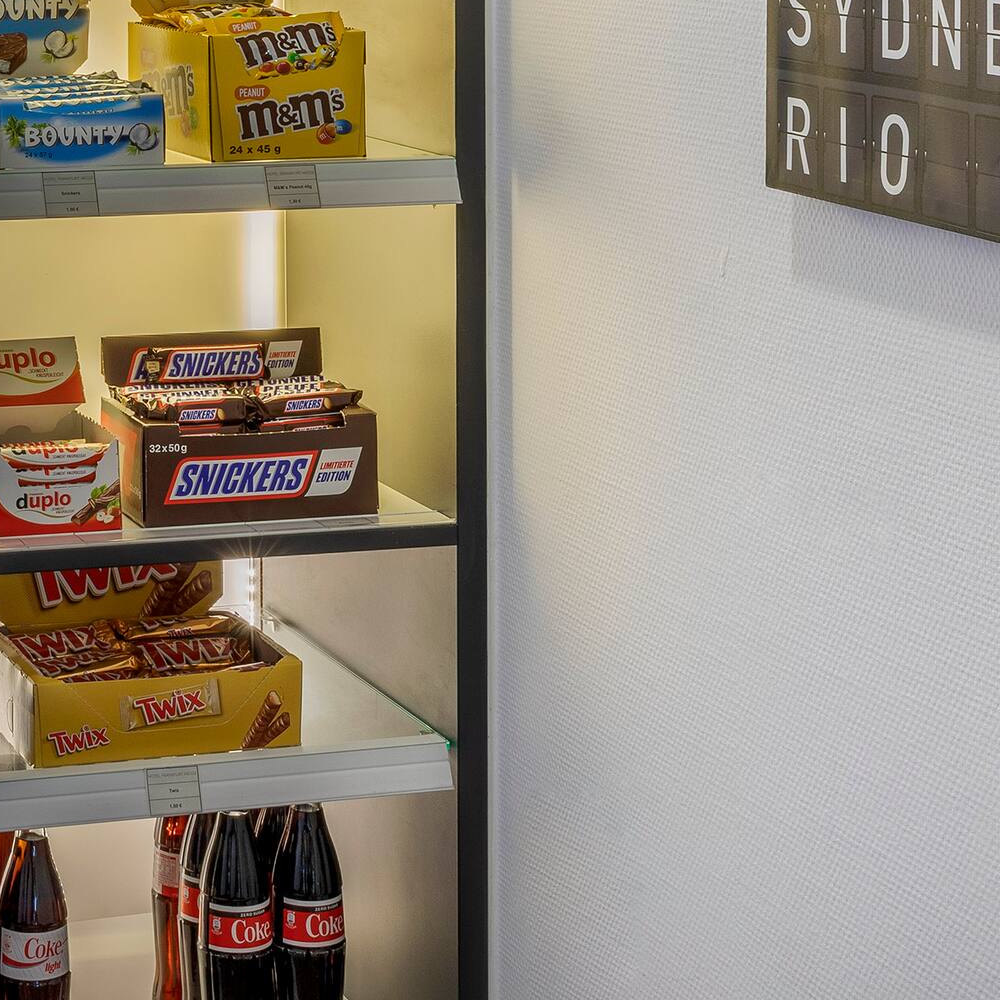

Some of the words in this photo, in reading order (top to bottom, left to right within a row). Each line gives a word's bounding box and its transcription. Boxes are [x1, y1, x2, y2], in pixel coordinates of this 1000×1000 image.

[231, 21, 258, 32] PEANUT
[239, 87, 266, 98] PEANUT
[24, 124, 126, 148] BOUNTY
[229, 146, 243, 155] 24
[256, 145, 271, 154] 45
[274, 146, 281, 155] g
[785, 95, 912, 196] RIO
[269, 351, 297, 359] LIMITIERTE
[169, 350, 263, 378] SNICKERS
[267, 359, 295, 369] EDITION
[286, 399, 322, 411] SNICKERS
[180, 409, 217, 422] SNICKERS
[320, 460, 355, 470] LIMITIERTE
[175, 457, 309, 498] SNICKERS
[316, 470, 352, 483] EDITION
[16, 491, 72, 516] duplo
[231, 919, 270, 944] Coke
[305, 913, 344, 938] Coke
[24, 936, 64, 960] Coke
[44, 959, 62, 974] light
